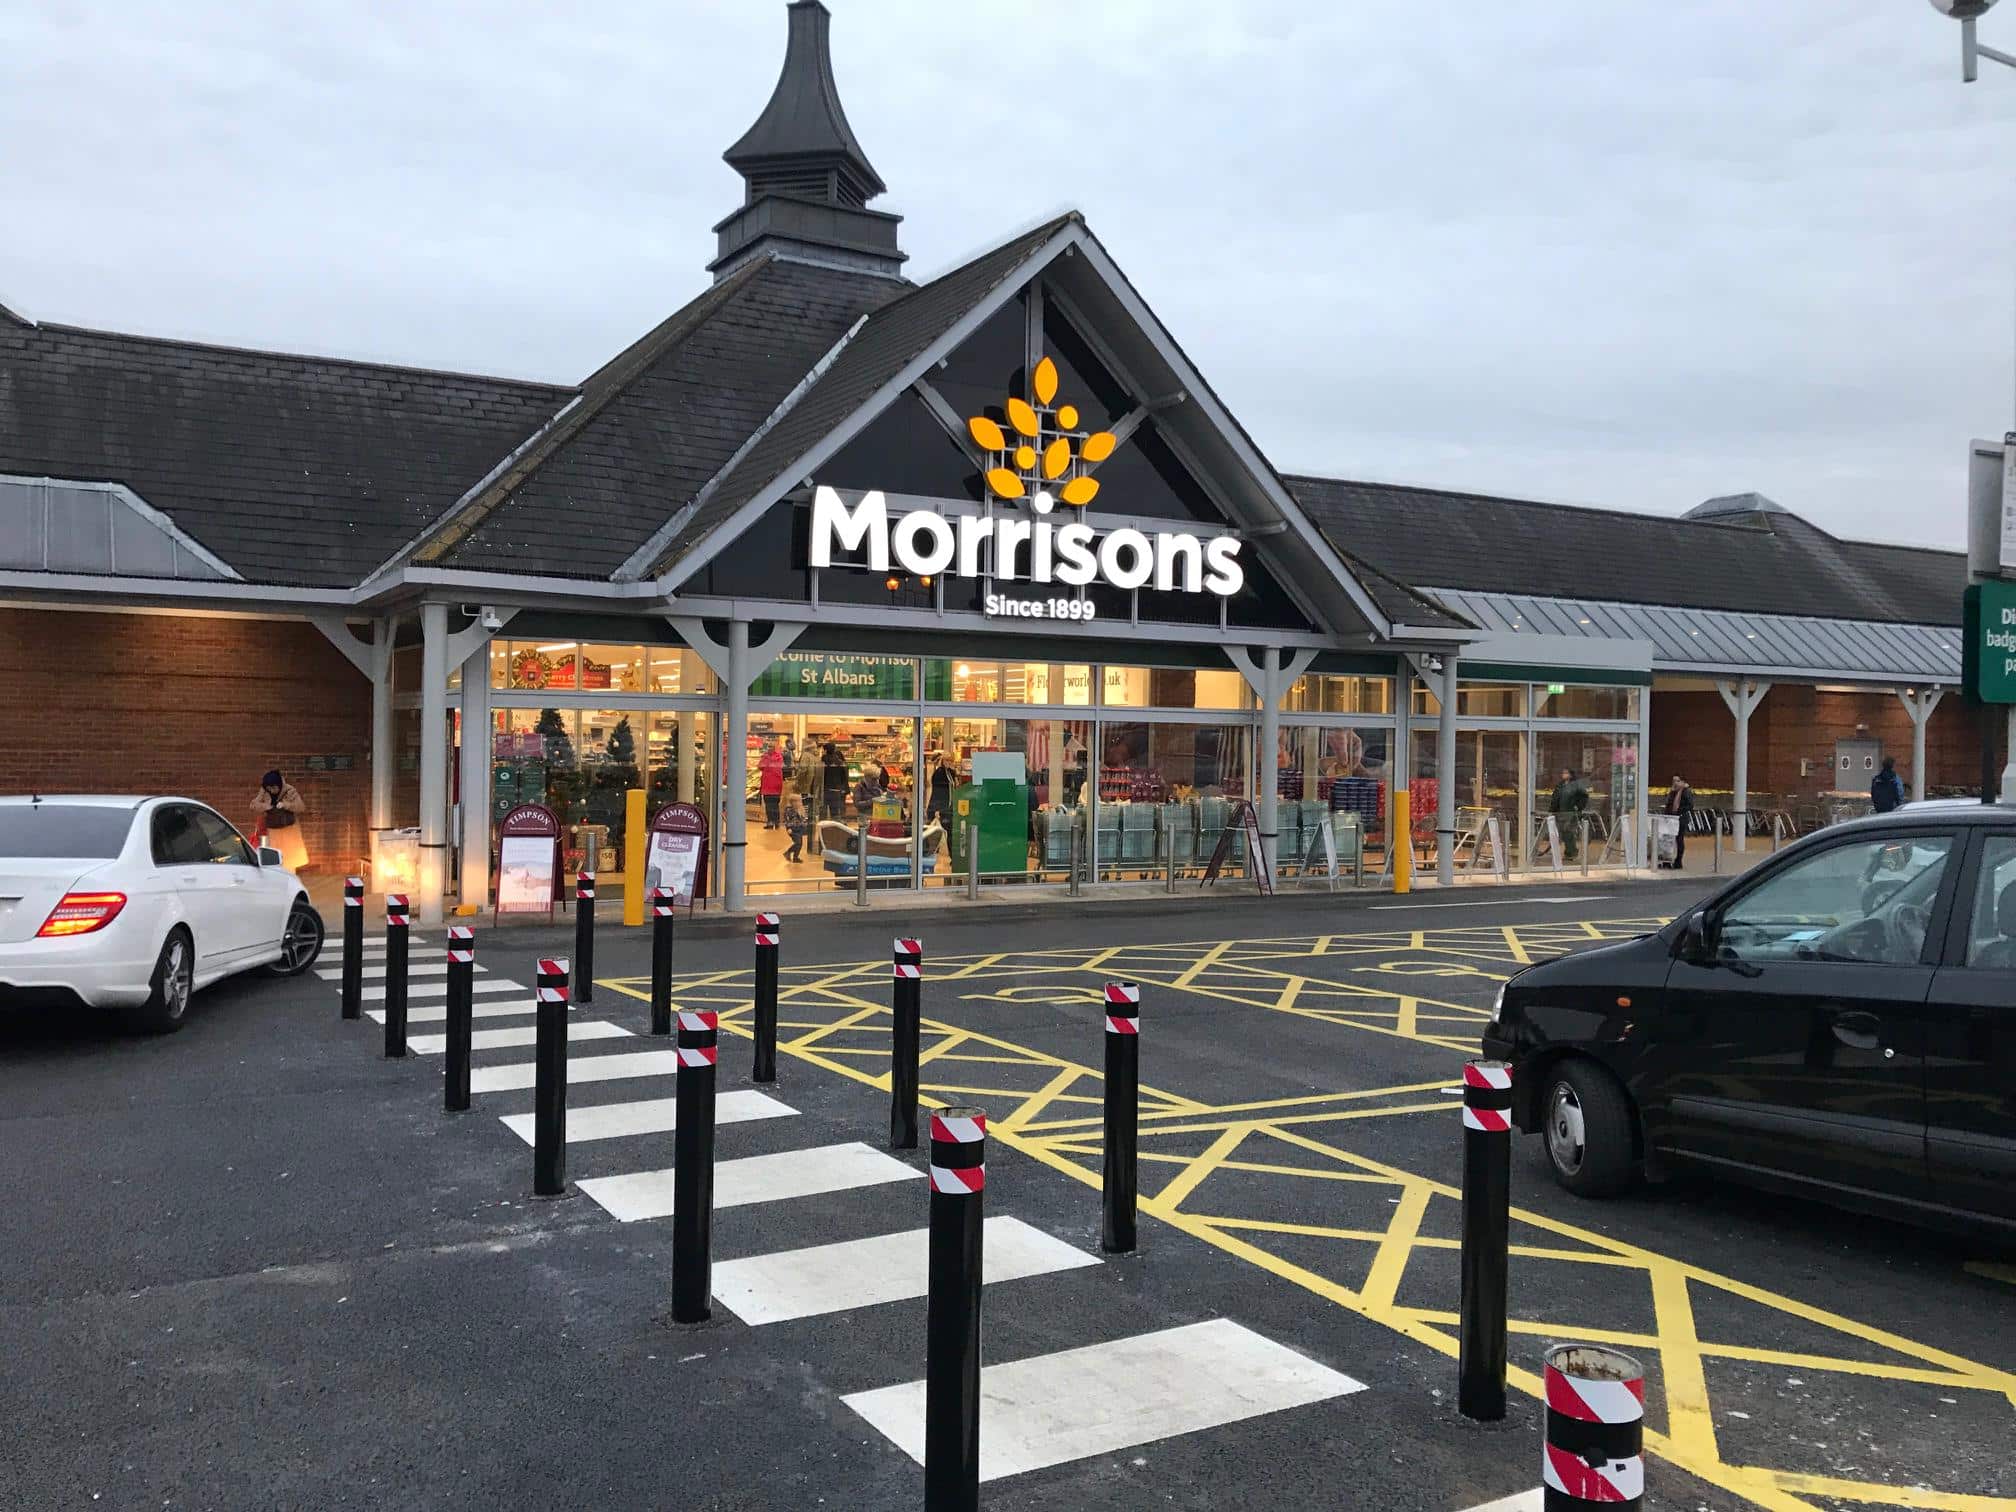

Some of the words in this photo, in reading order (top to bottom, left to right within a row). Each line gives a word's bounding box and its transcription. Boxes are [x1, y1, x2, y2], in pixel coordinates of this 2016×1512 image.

[809, 486, 1245, 596] Morrisons
[986, 595, 1043, 617] Since
[1047, 598, 1095, 620] 1899
[801, 668, 817, 684] St
[822, 668, 875, 685] Albans
[508, 811, 551, 826] TIMPSON
[660, 809, 700, 824] TIMPSON
